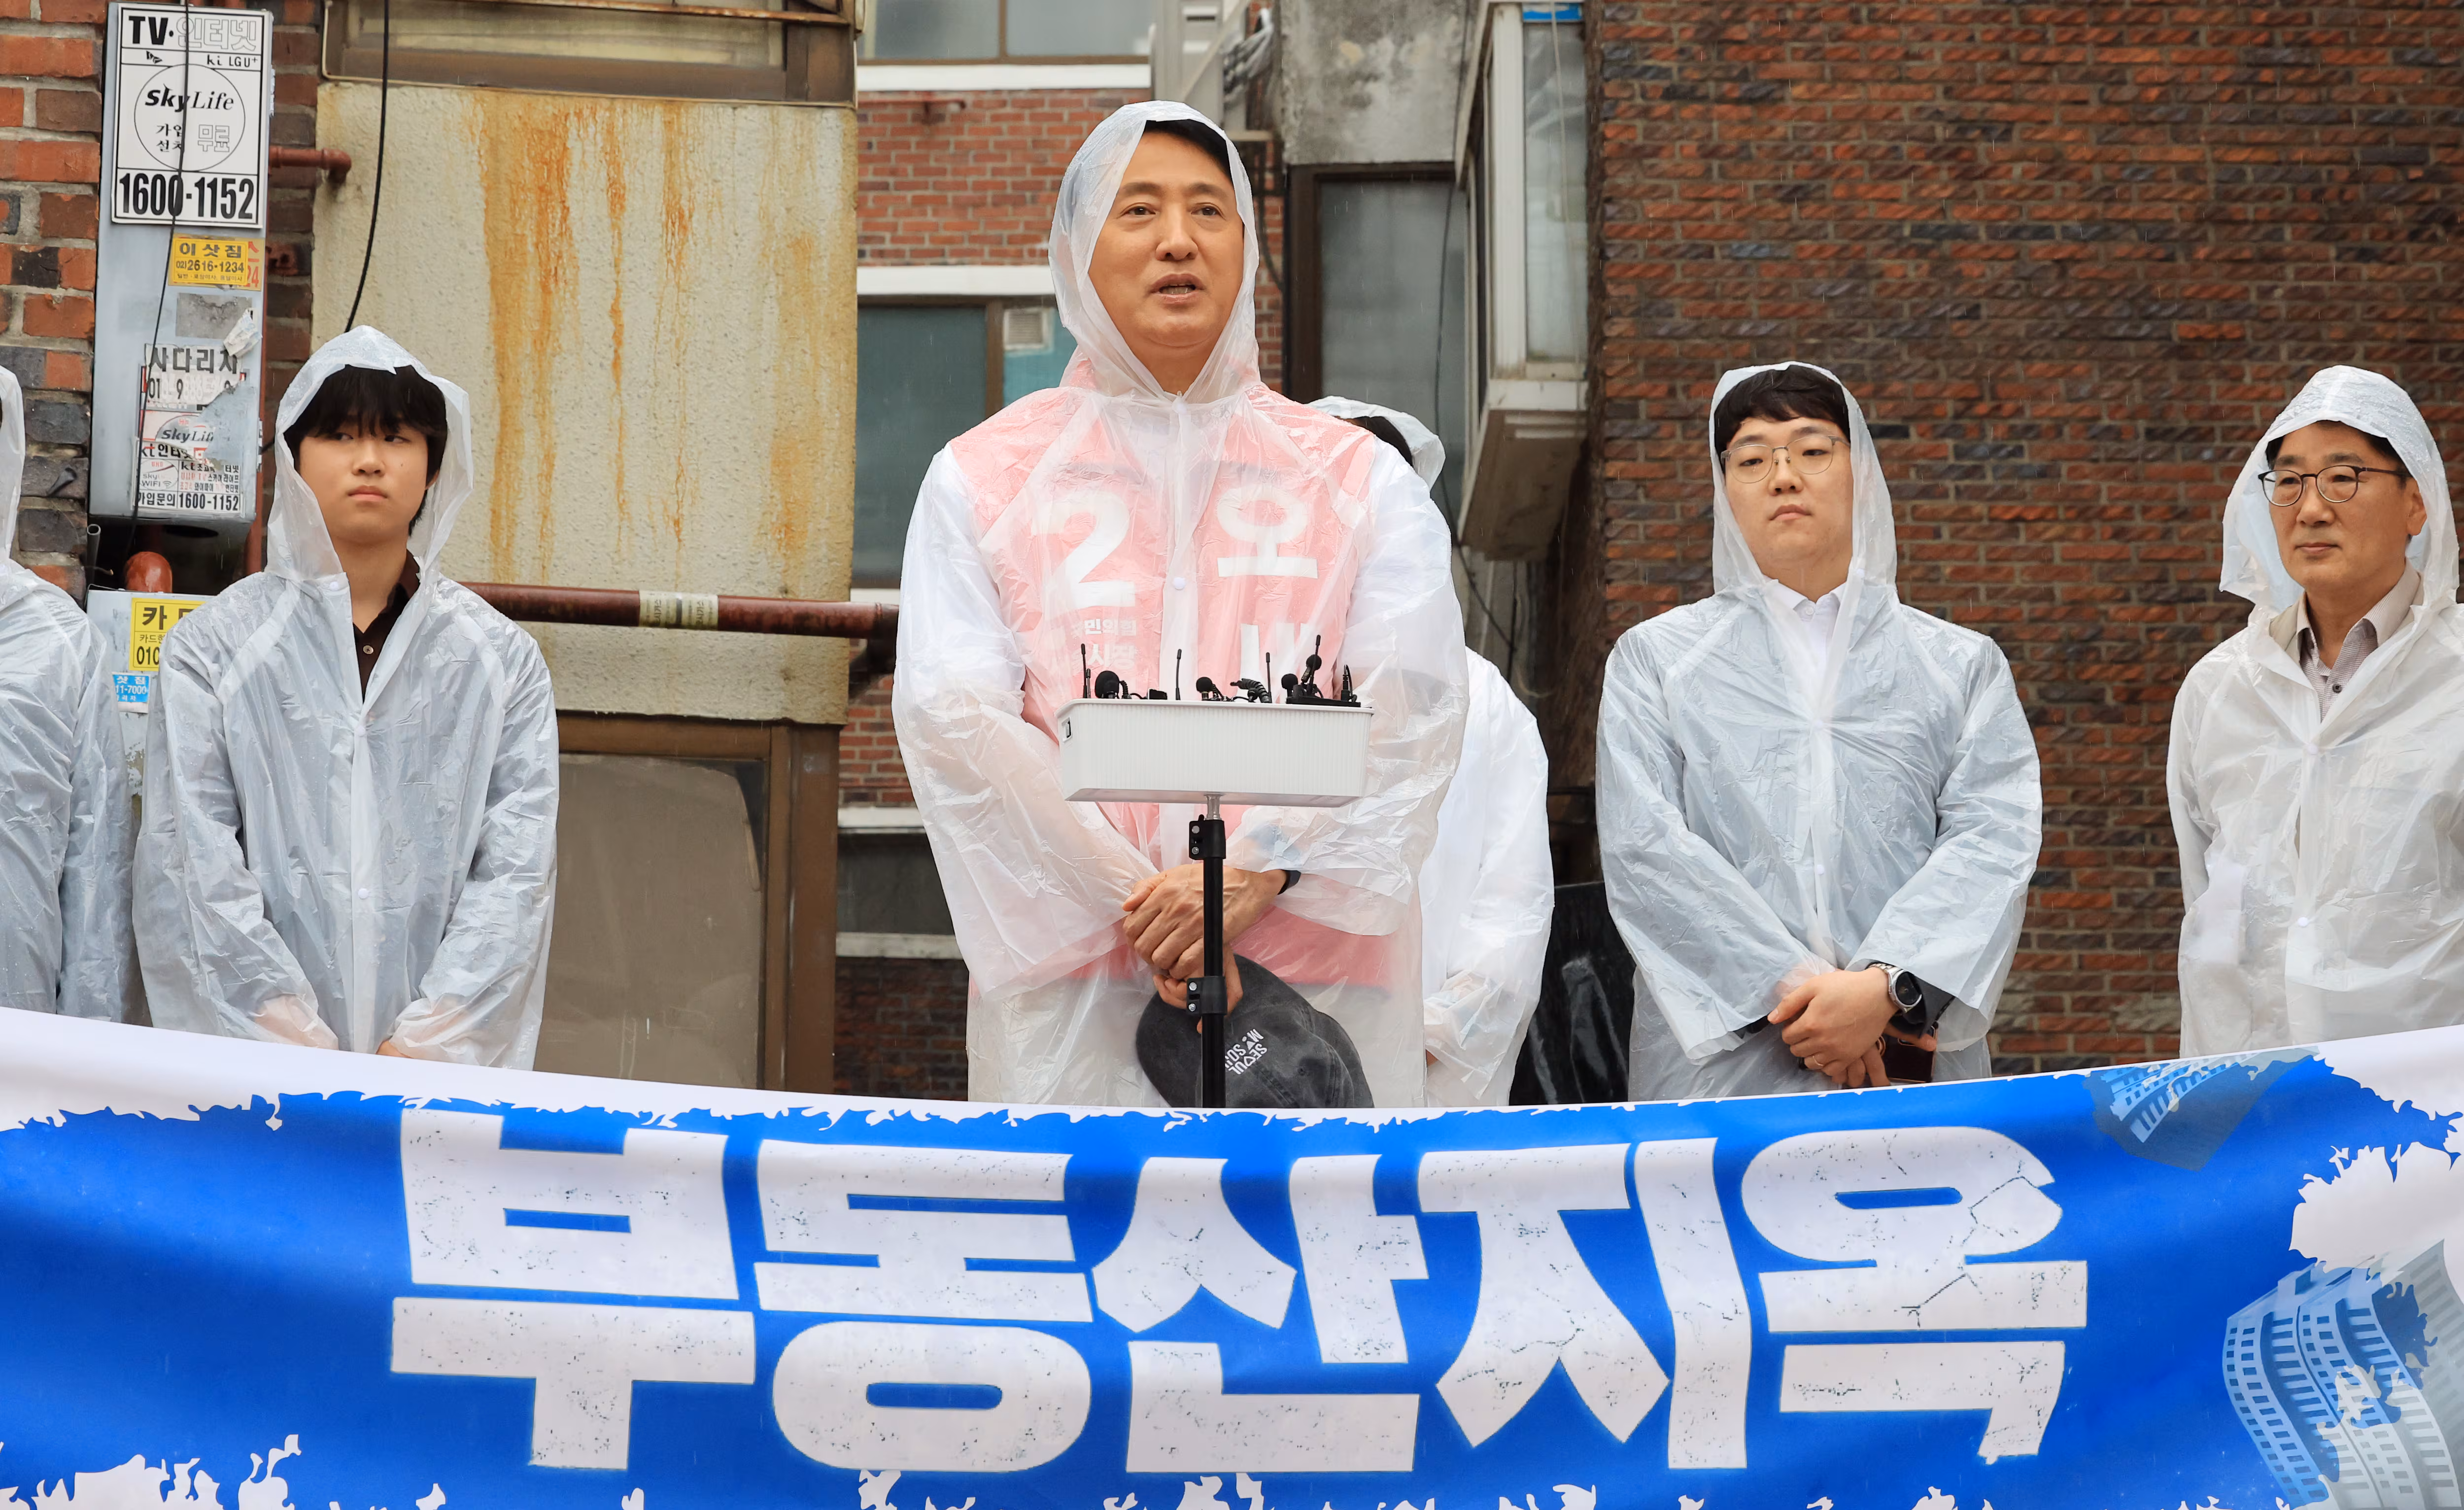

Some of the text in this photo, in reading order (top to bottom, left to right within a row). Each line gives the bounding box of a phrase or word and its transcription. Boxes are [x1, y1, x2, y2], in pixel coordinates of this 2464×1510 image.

[198, 124, 230, 152] 무료
[119, 173, 254, 219] 1600-1152
[179, 493, 239, 511] 1600-1152
[1030, 487, 1135, 610] 2
